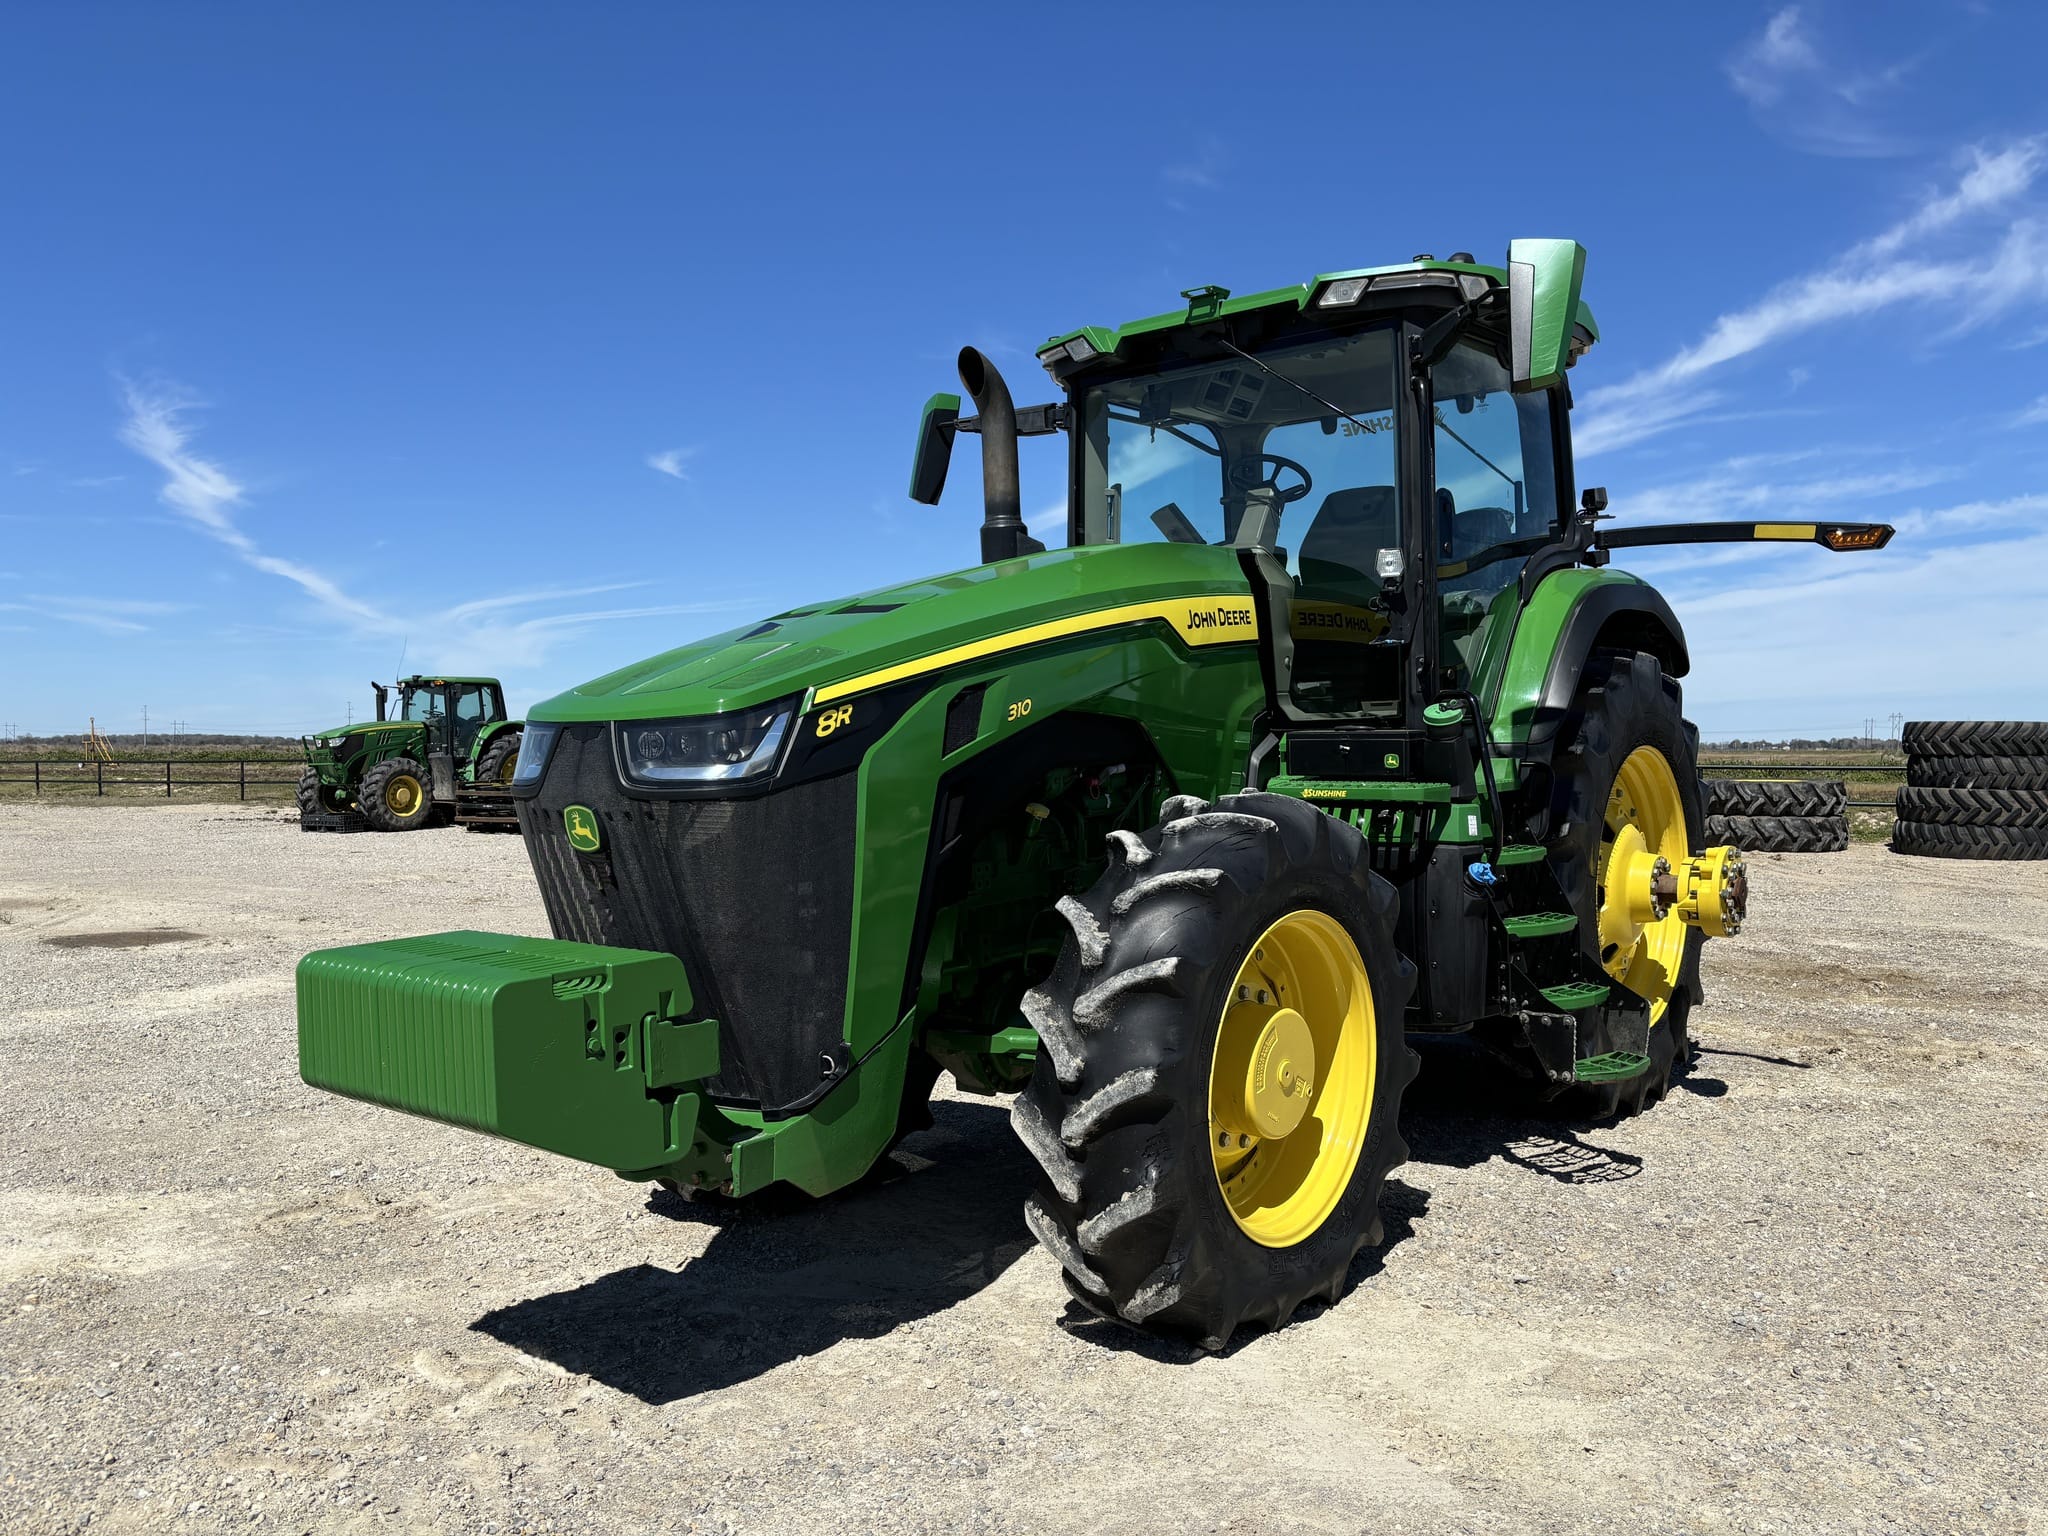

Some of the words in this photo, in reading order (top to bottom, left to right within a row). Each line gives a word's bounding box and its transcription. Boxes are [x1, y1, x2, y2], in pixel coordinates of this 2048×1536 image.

[1187, 609, 1217, 630] JOHN
[1218, 607, 1252, 627] DEERE
[815, 703, 854, 738] 8R
[1007, 698, 1033, 722] 310
[1306, 788, 1348, 797] SUNSHINE
